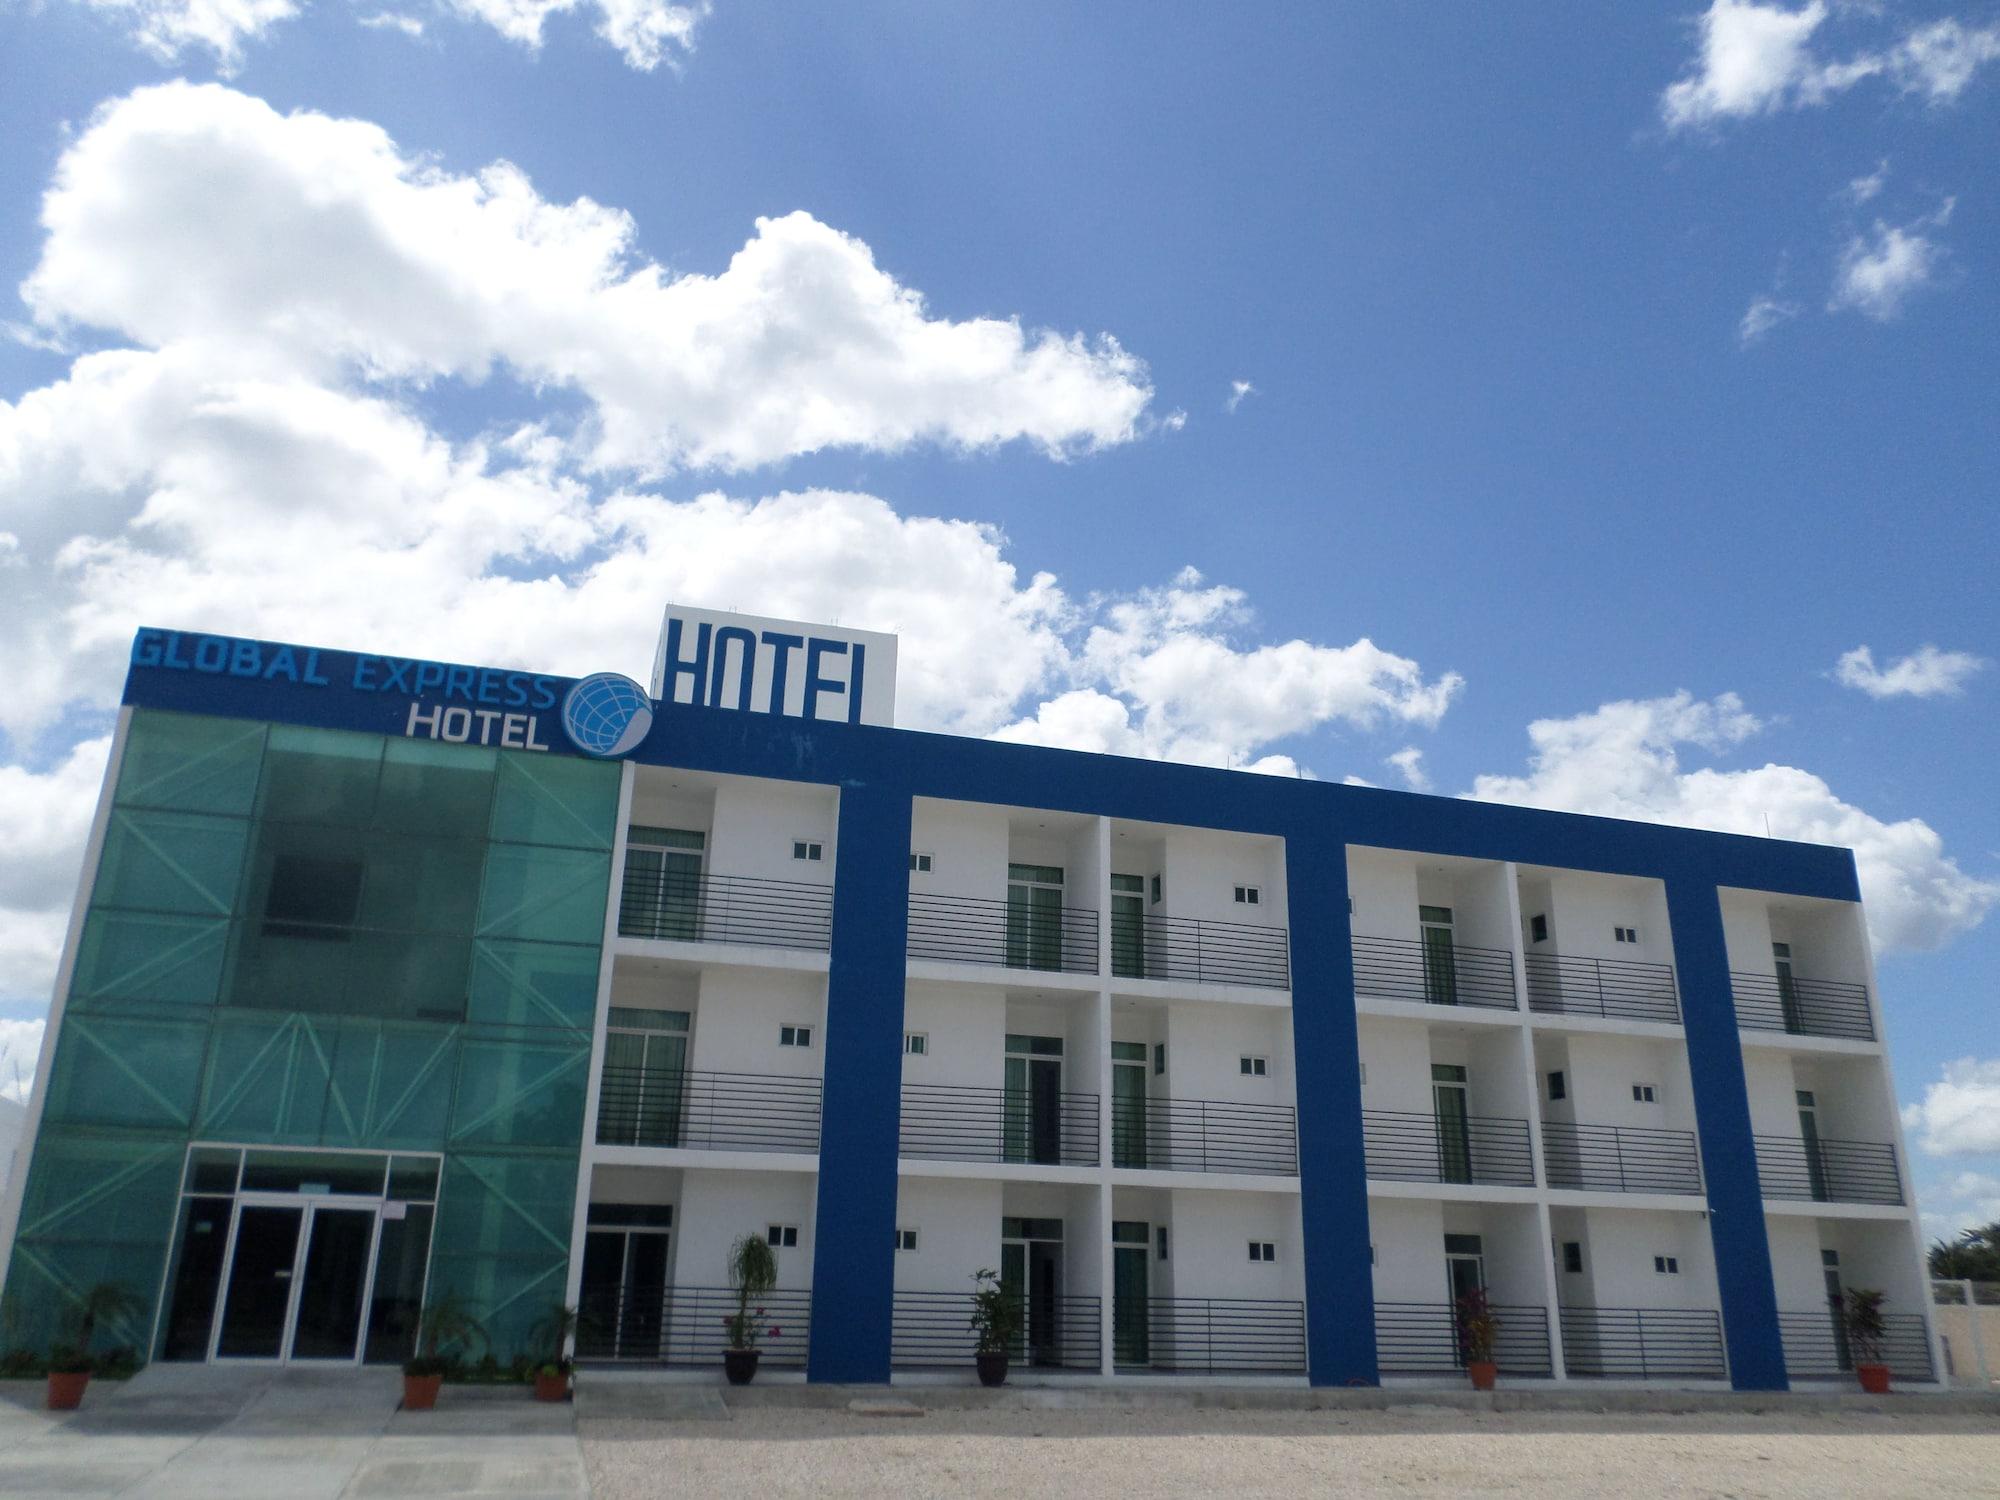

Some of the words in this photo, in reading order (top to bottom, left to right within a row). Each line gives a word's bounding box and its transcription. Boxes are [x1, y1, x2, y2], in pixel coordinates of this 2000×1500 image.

[132, 629, 329, 686] GLOBAL
[353, 654, 557, 710] EXPRESS
[405, 702, 549, 751] HOTEL
